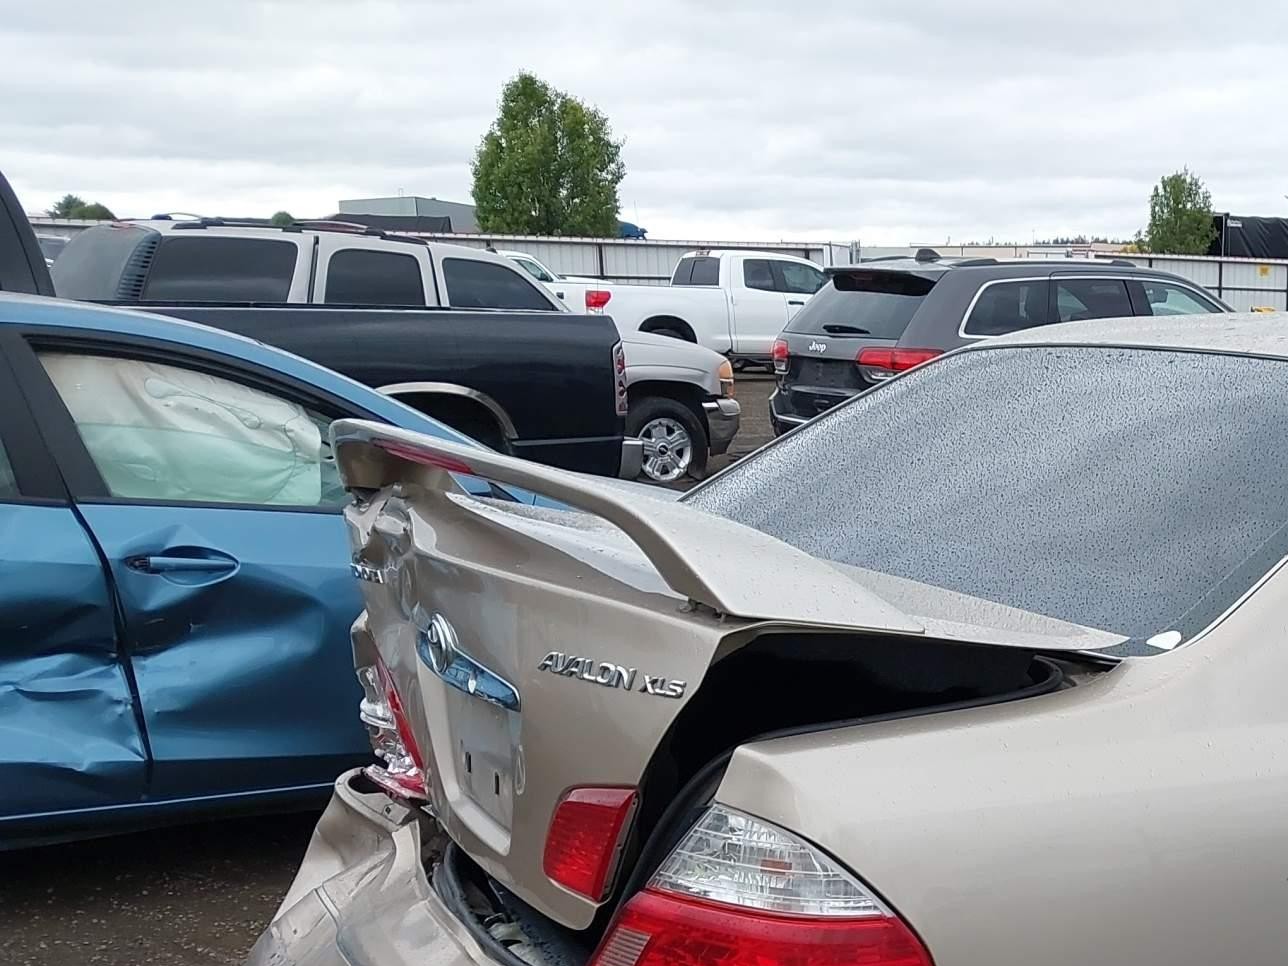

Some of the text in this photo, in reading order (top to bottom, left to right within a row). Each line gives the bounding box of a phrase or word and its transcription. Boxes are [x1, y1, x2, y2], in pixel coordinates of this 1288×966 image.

[808, 340, 827, 353] Jeep
[538, 651, 687, 699] AVALON XLS
